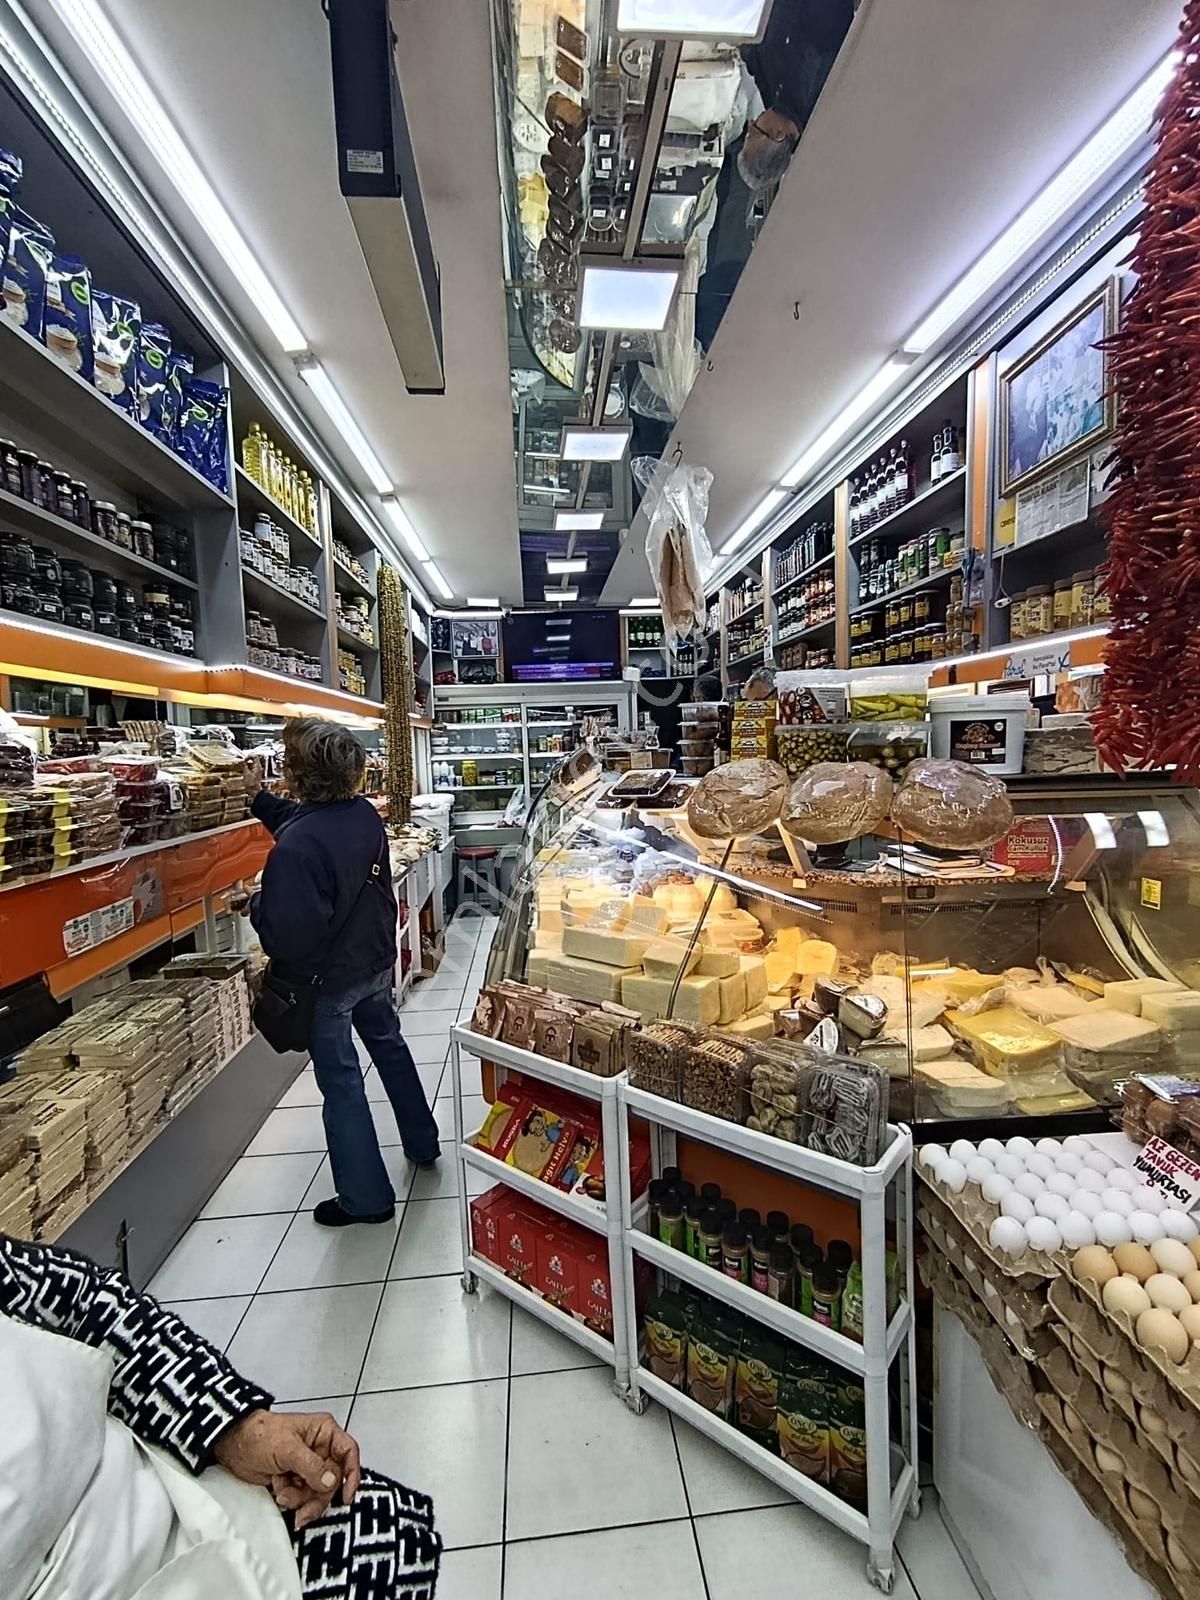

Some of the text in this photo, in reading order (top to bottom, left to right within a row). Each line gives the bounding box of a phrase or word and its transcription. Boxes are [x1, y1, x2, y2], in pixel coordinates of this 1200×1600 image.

[1008, 835, 1048, 844] Kokusuz
[1148, 1138, 1168, 1153] AZ
[543, 1161, 557, 1182] agic
[1144, 1147, 1178, 1179] TAVUK
[1132, 1155, 1193, 1204] YUMURTASI
